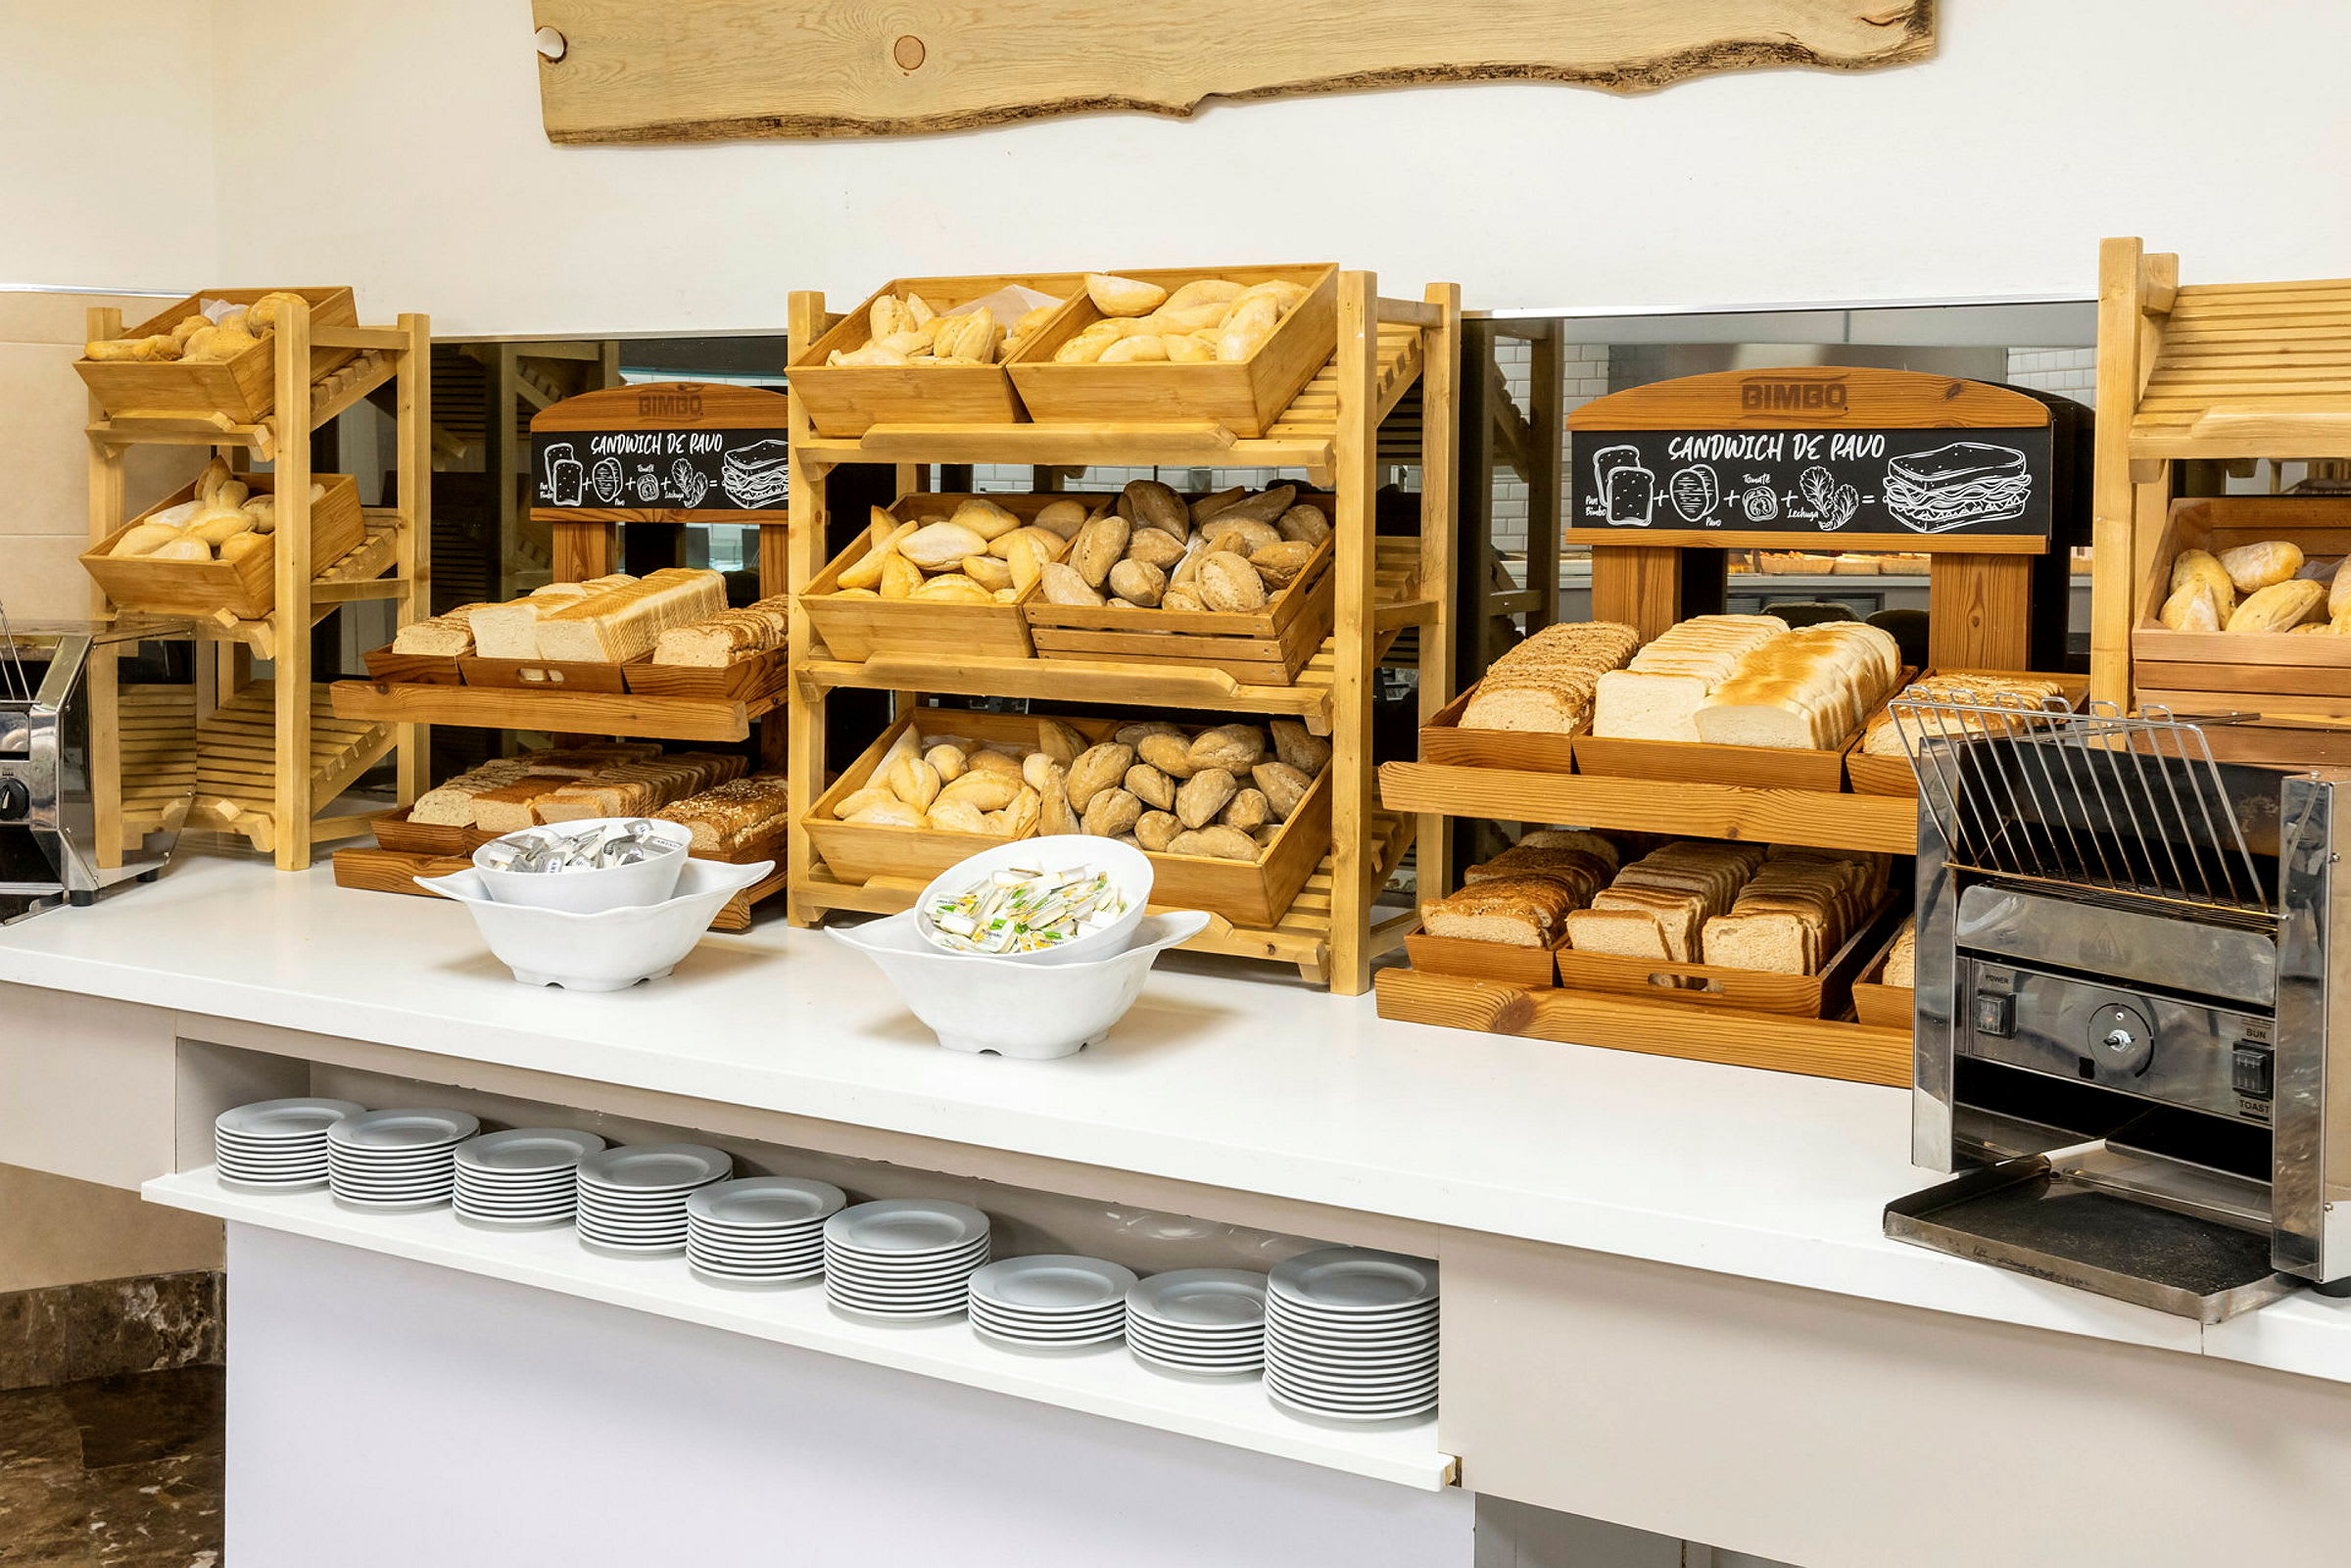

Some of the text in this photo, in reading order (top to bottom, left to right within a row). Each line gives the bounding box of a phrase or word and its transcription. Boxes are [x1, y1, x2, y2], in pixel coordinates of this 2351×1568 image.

[638, 394, 703, 416] BIMBO
[1742, 384, 1847, 410] BIMBO
[590, 432, 723, 455] SANDWICH DE PAVO
[1667, 432, 1886, 462] SANDWICH DE PAVO
[1787, 506, 1819, 522] Lechuga
[2246, 1028, 2267, 1039] BUN
[2239, 1099, 2270, 1114] TOAST
